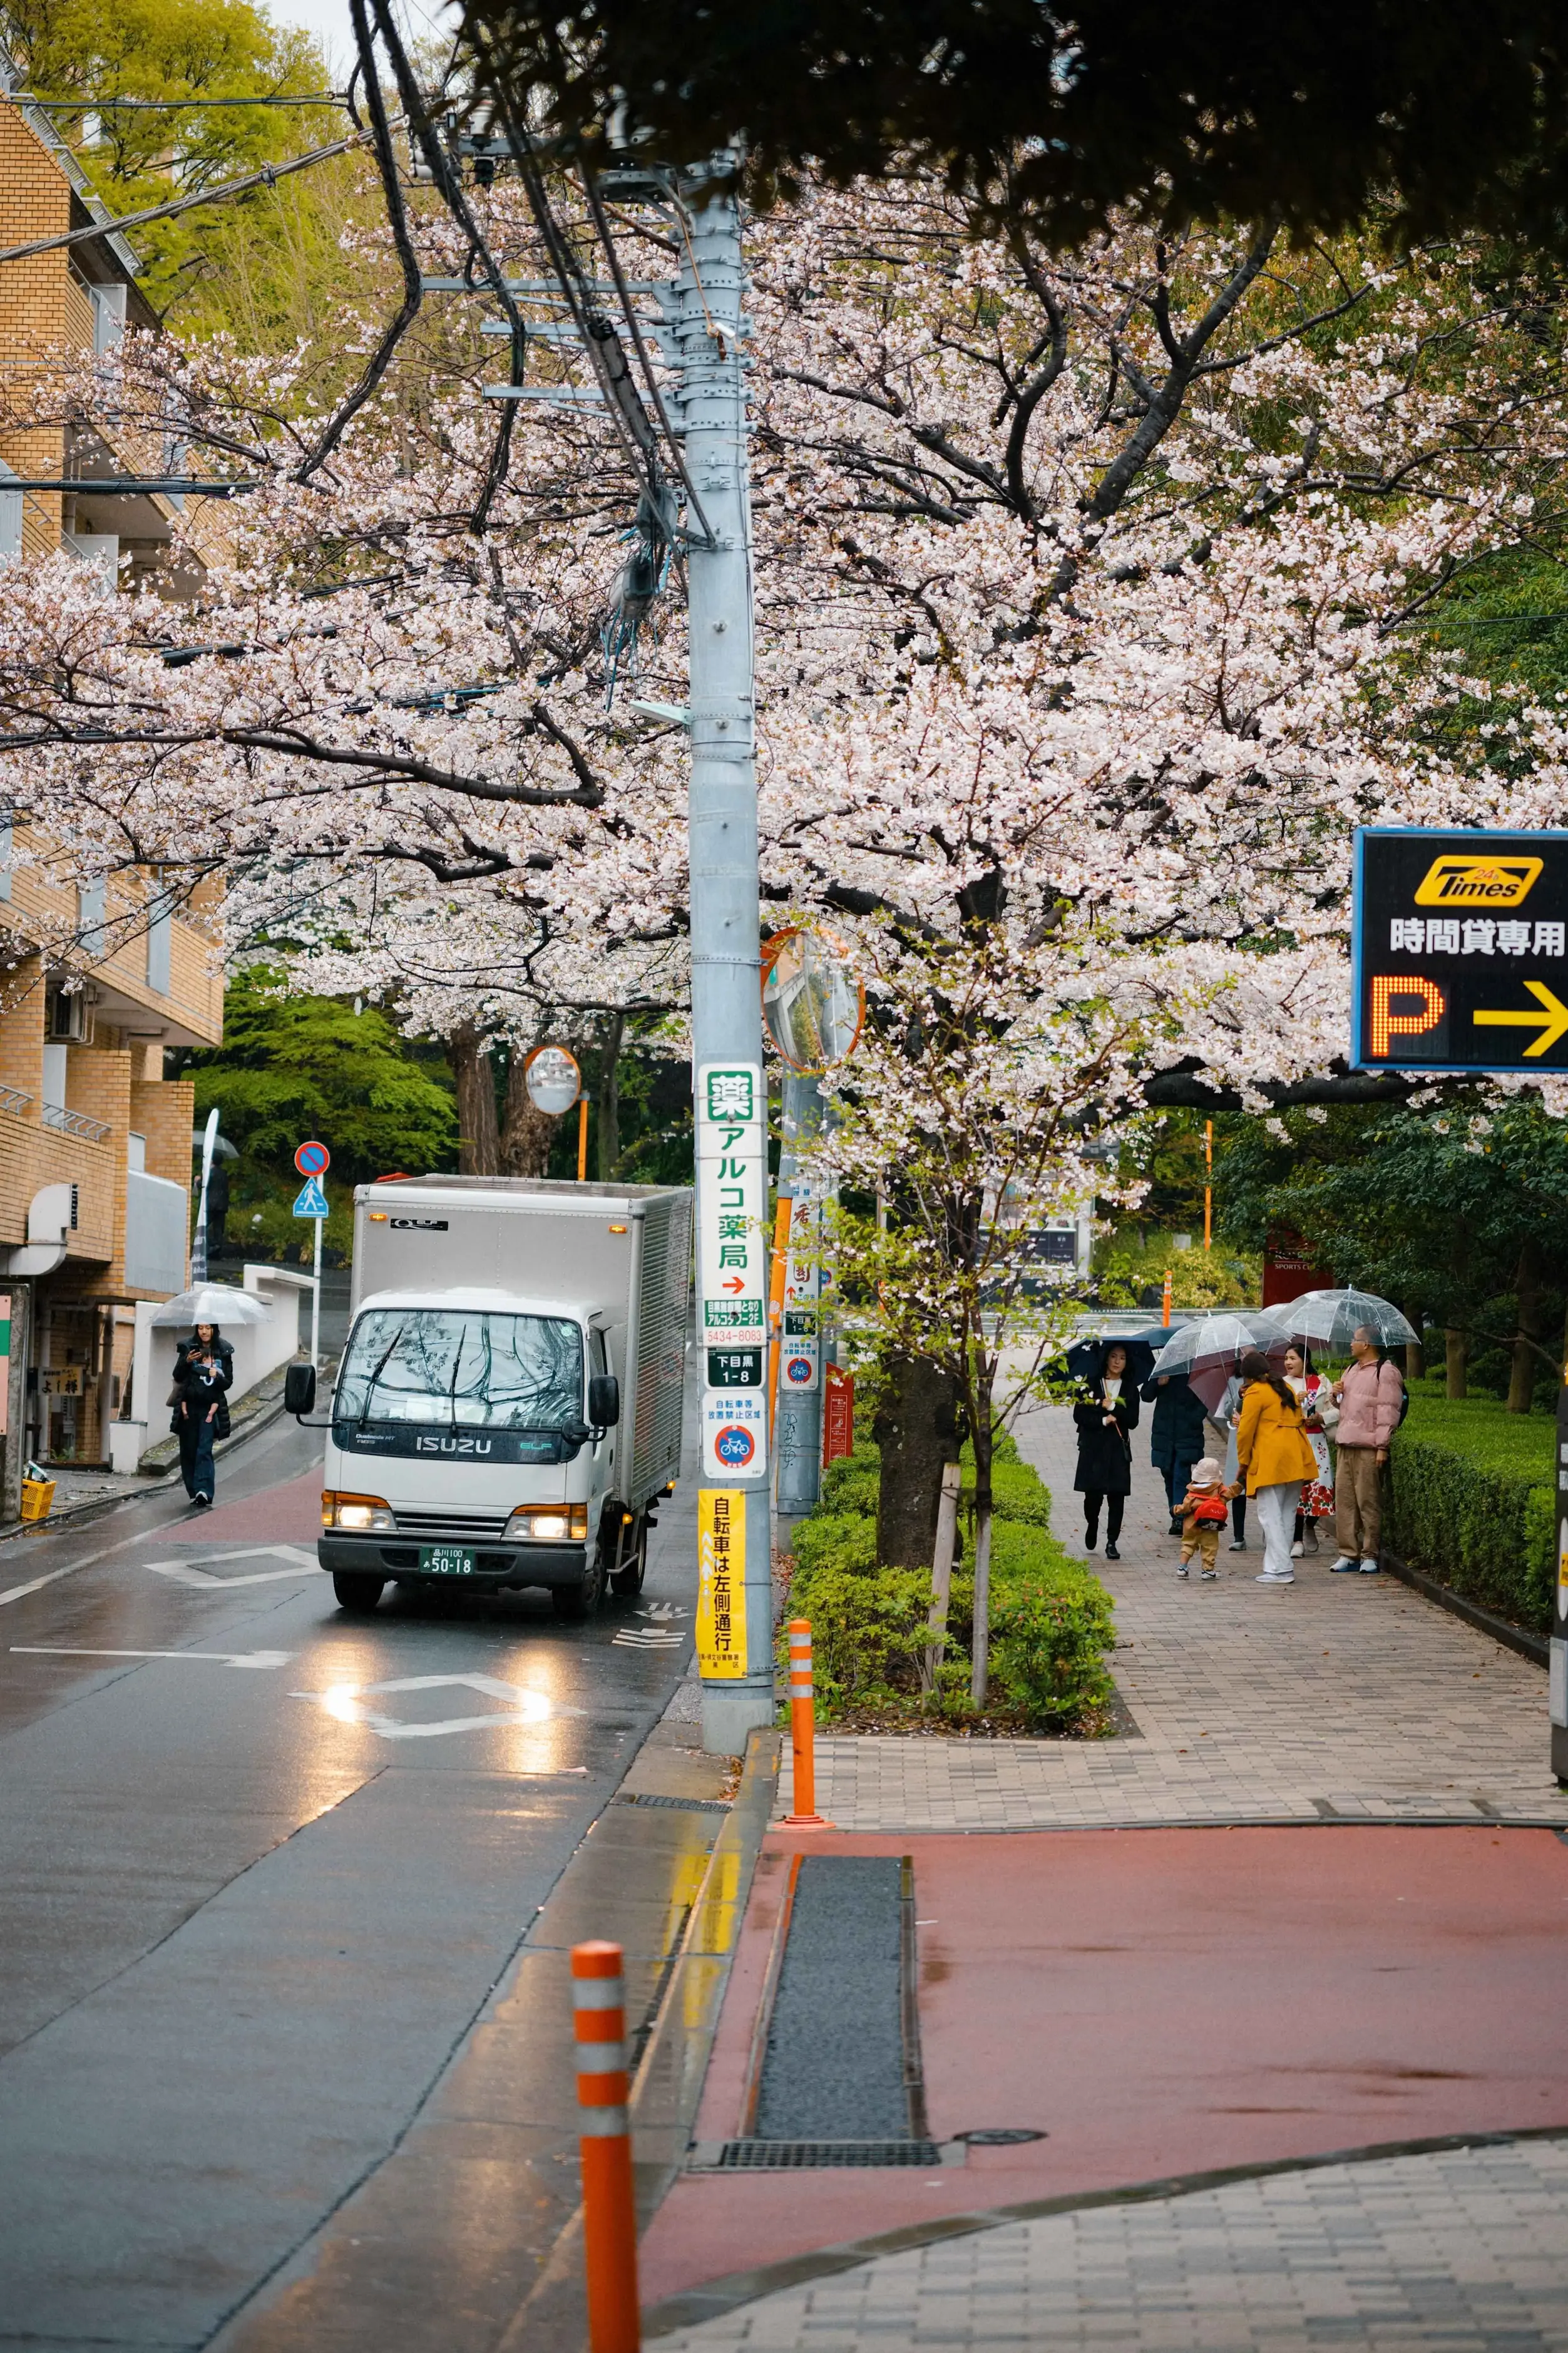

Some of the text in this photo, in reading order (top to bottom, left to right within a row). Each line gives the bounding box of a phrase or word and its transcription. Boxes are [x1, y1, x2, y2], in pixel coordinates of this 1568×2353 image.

[1438, 876, 1520, 898] Times
[1390, 917, 1565, 956] 時間貸専用
[1372, 976, 1444, 1057] P
[711, 1074, 750, 1117] 薬
[717, 1127, 747, 1270] アルコ薬局
[708, 1330, 761, 1342] 5434-8083
[717, 1356, 754, 1367] 下目黒
[722, 1371, 749, 1382] 1-8
[416, 1436, 491, 1454] ISUZU
[520, 1442, 553, 1450] ELF
[432, 1557, 471, 1574] 50-18
[713, 1497, 732, 1652] 自転車は左側通行
